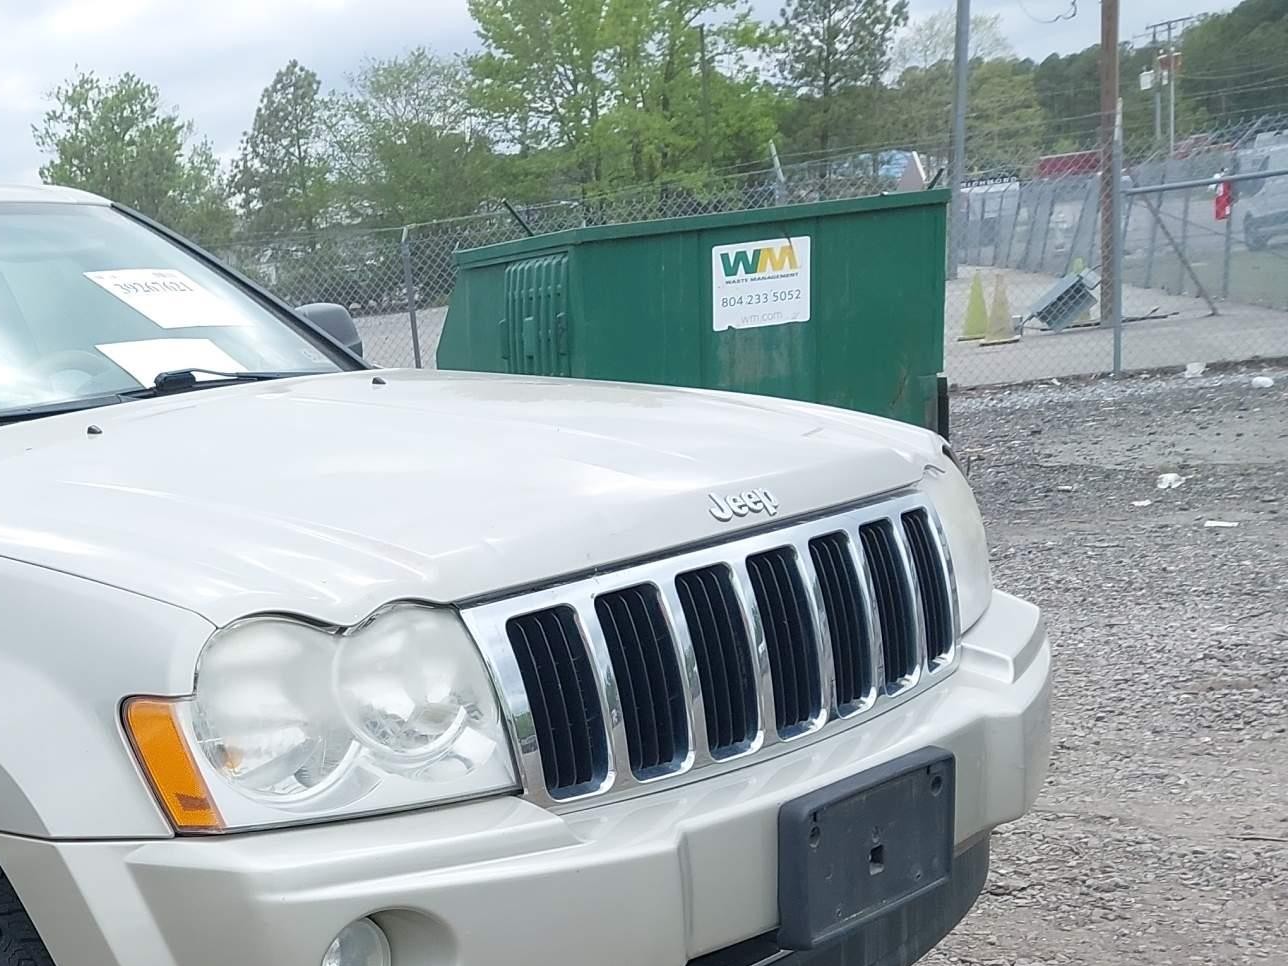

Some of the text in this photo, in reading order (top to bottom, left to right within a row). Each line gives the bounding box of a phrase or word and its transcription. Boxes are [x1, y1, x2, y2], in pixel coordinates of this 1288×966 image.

[720, 245, 799, 278] WM
[750, 273, 799, 282] MANAGEMENT
[113, 281, 194, 295] 39267621
[722, 289, 802, 308] 804 233 5052
[707, 487, 779, 523] Jeep
